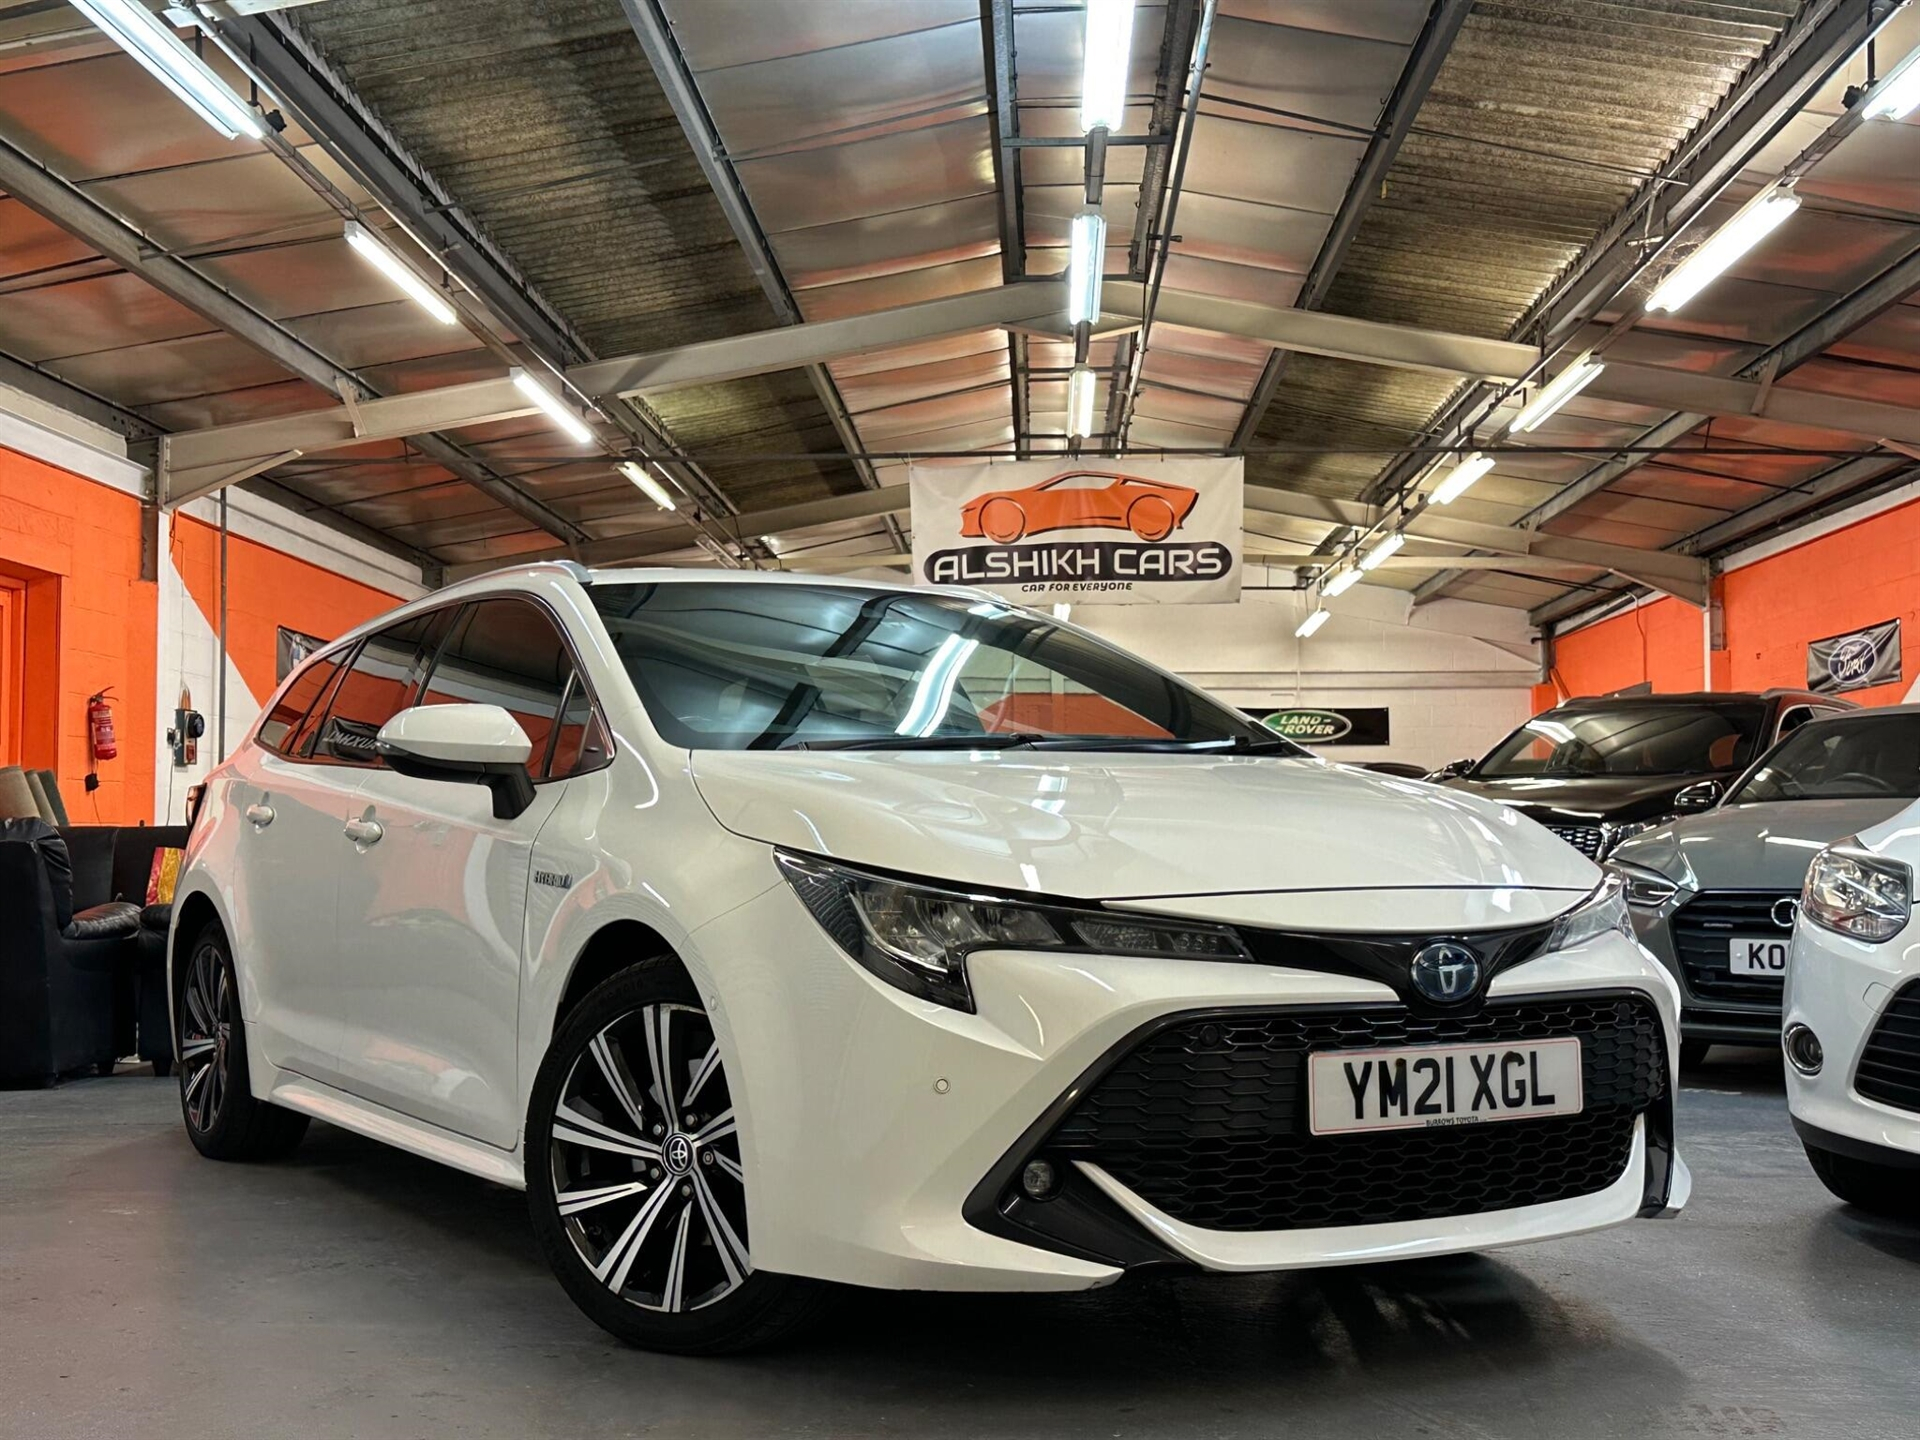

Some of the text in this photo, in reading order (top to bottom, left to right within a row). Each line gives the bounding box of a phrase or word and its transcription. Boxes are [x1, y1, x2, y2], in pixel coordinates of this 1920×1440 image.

[934, 548, 1222, 581] ALSHIKH CARS
[1021, 582, 1133, 592] CAR FOR EVERYONE
[1280, 715, 1321, 724] LAND
[1284, 725, 1335, 735] ROVER
[1343, 1051, 1556, 1119] YM21 XGL
[1456, 1116, 1479, 1125] TOYOTA
